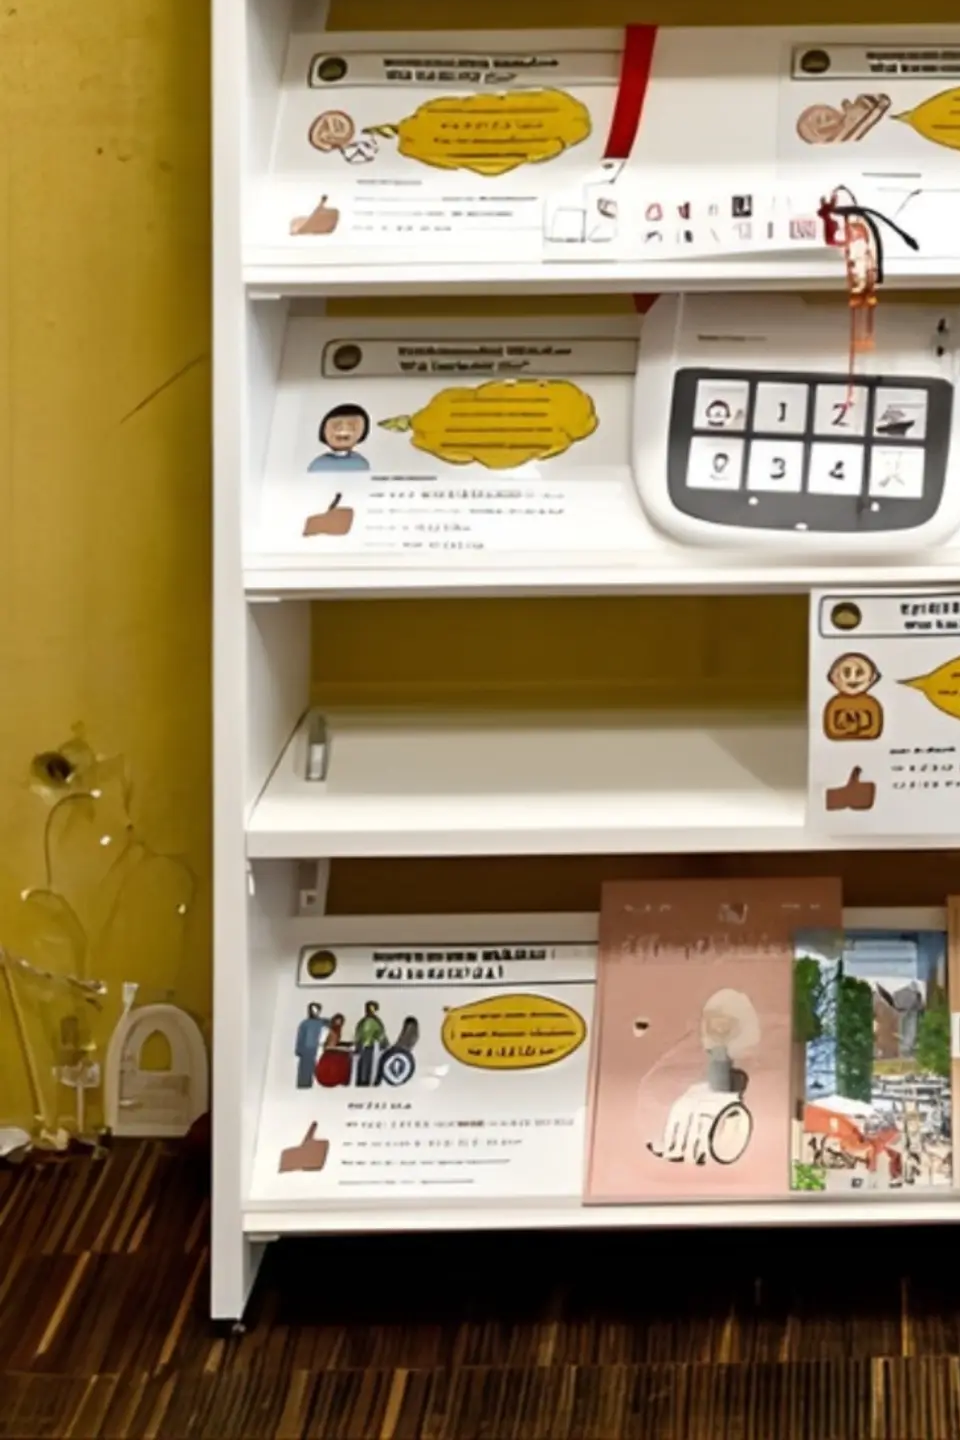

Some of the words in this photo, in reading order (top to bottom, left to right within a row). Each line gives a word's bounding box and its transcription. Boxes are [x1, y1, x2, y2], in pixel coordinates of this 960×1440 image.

[777, 402, 787, 422] 1
[831, 403, 851, 427] 2
[770, 456, 786, 480] 3
